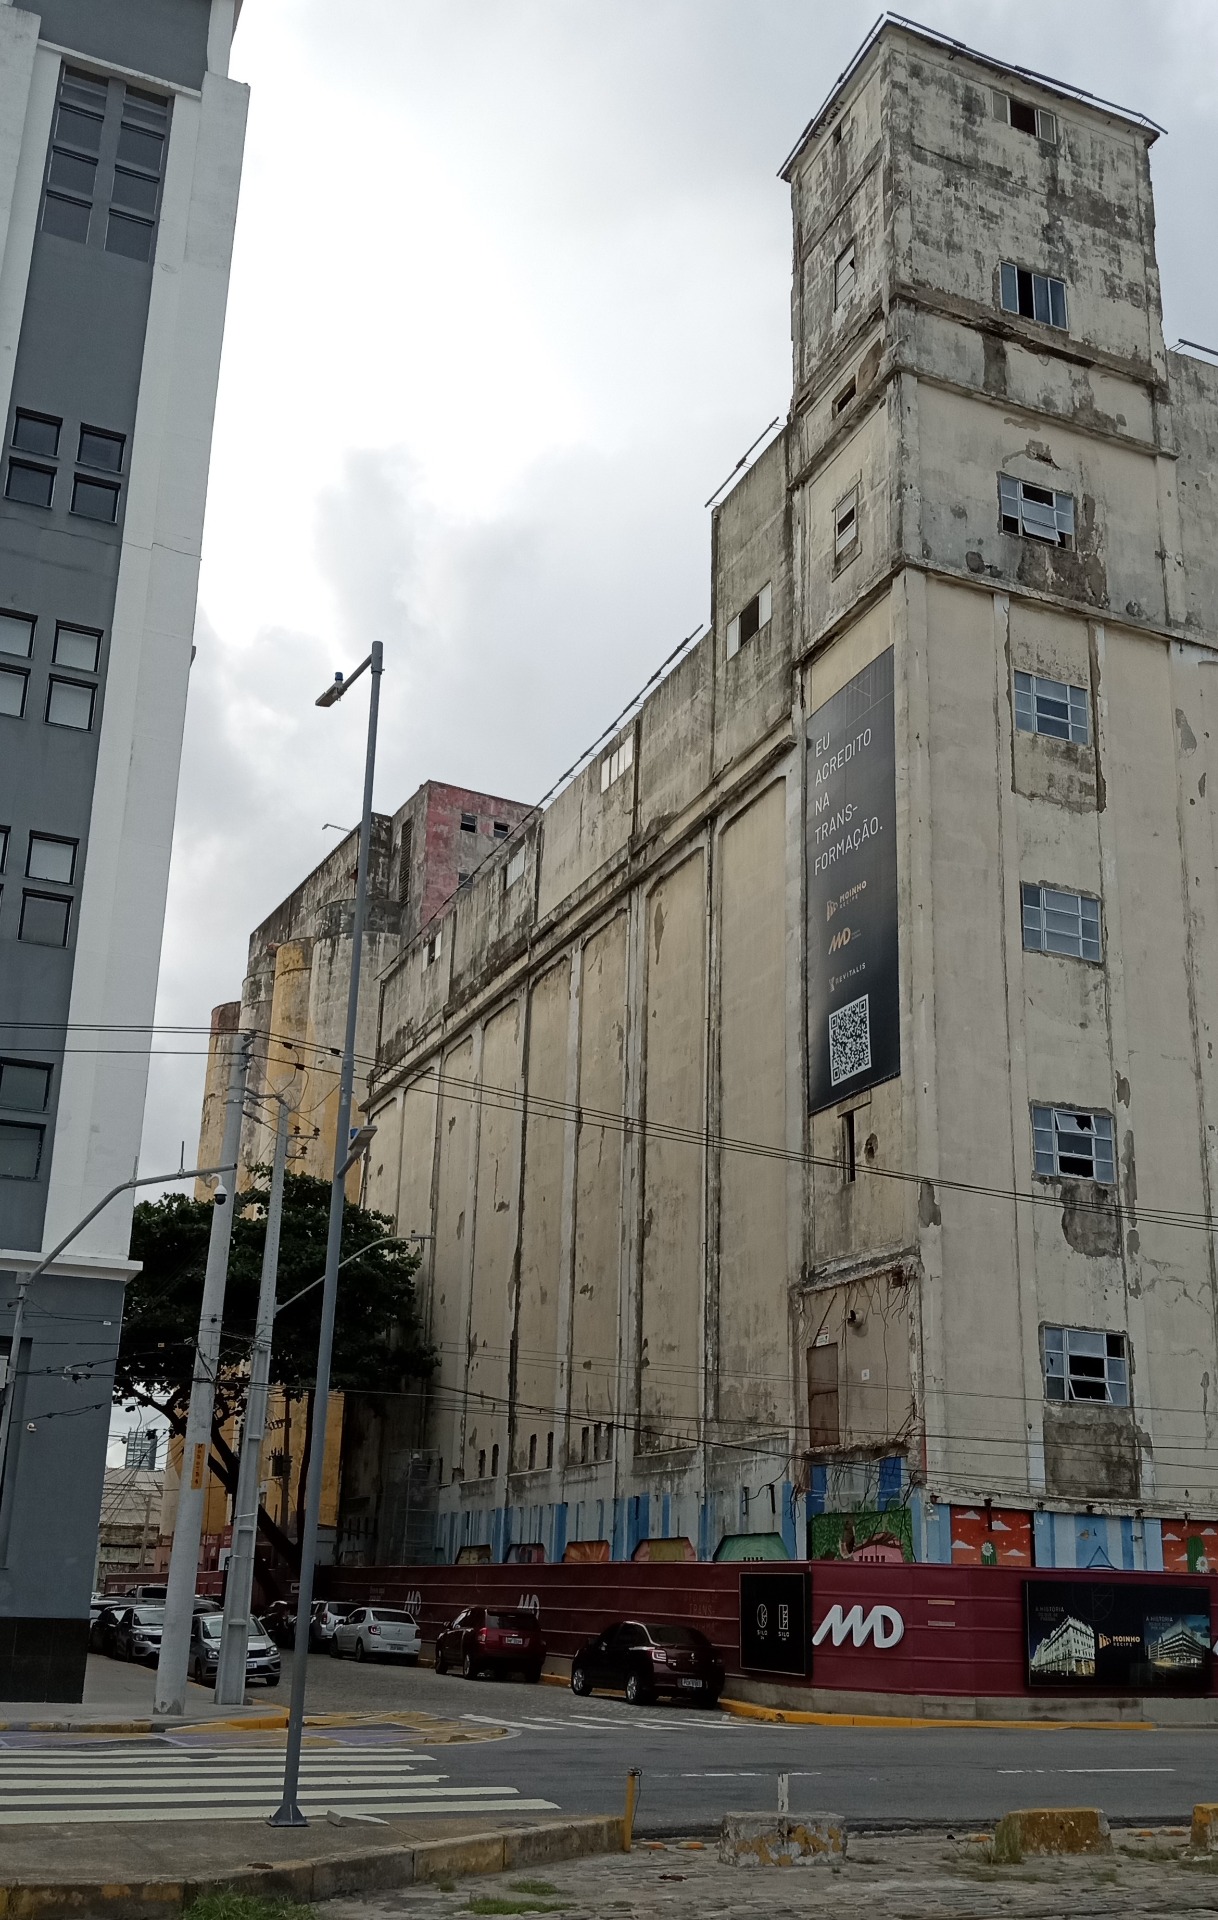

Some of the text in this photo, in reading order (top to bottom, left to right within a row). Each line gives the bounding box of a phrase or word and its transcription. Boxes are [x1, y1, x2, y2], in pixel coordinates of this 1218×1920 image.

[815, 731, 830, 758] EU
[815, 728, 872, 787] ACREDITO
[815, 792, 830, 816] NA
[815, 803, 858, 845] TRANS-
[815, 816, 883, 876] FORMAÇÃO.
[839, 880, 867, 904] MOINHO
[834, 962, 867, 985] REVITALIS
[1112, 1635, 1141, 1643] MOINHO
